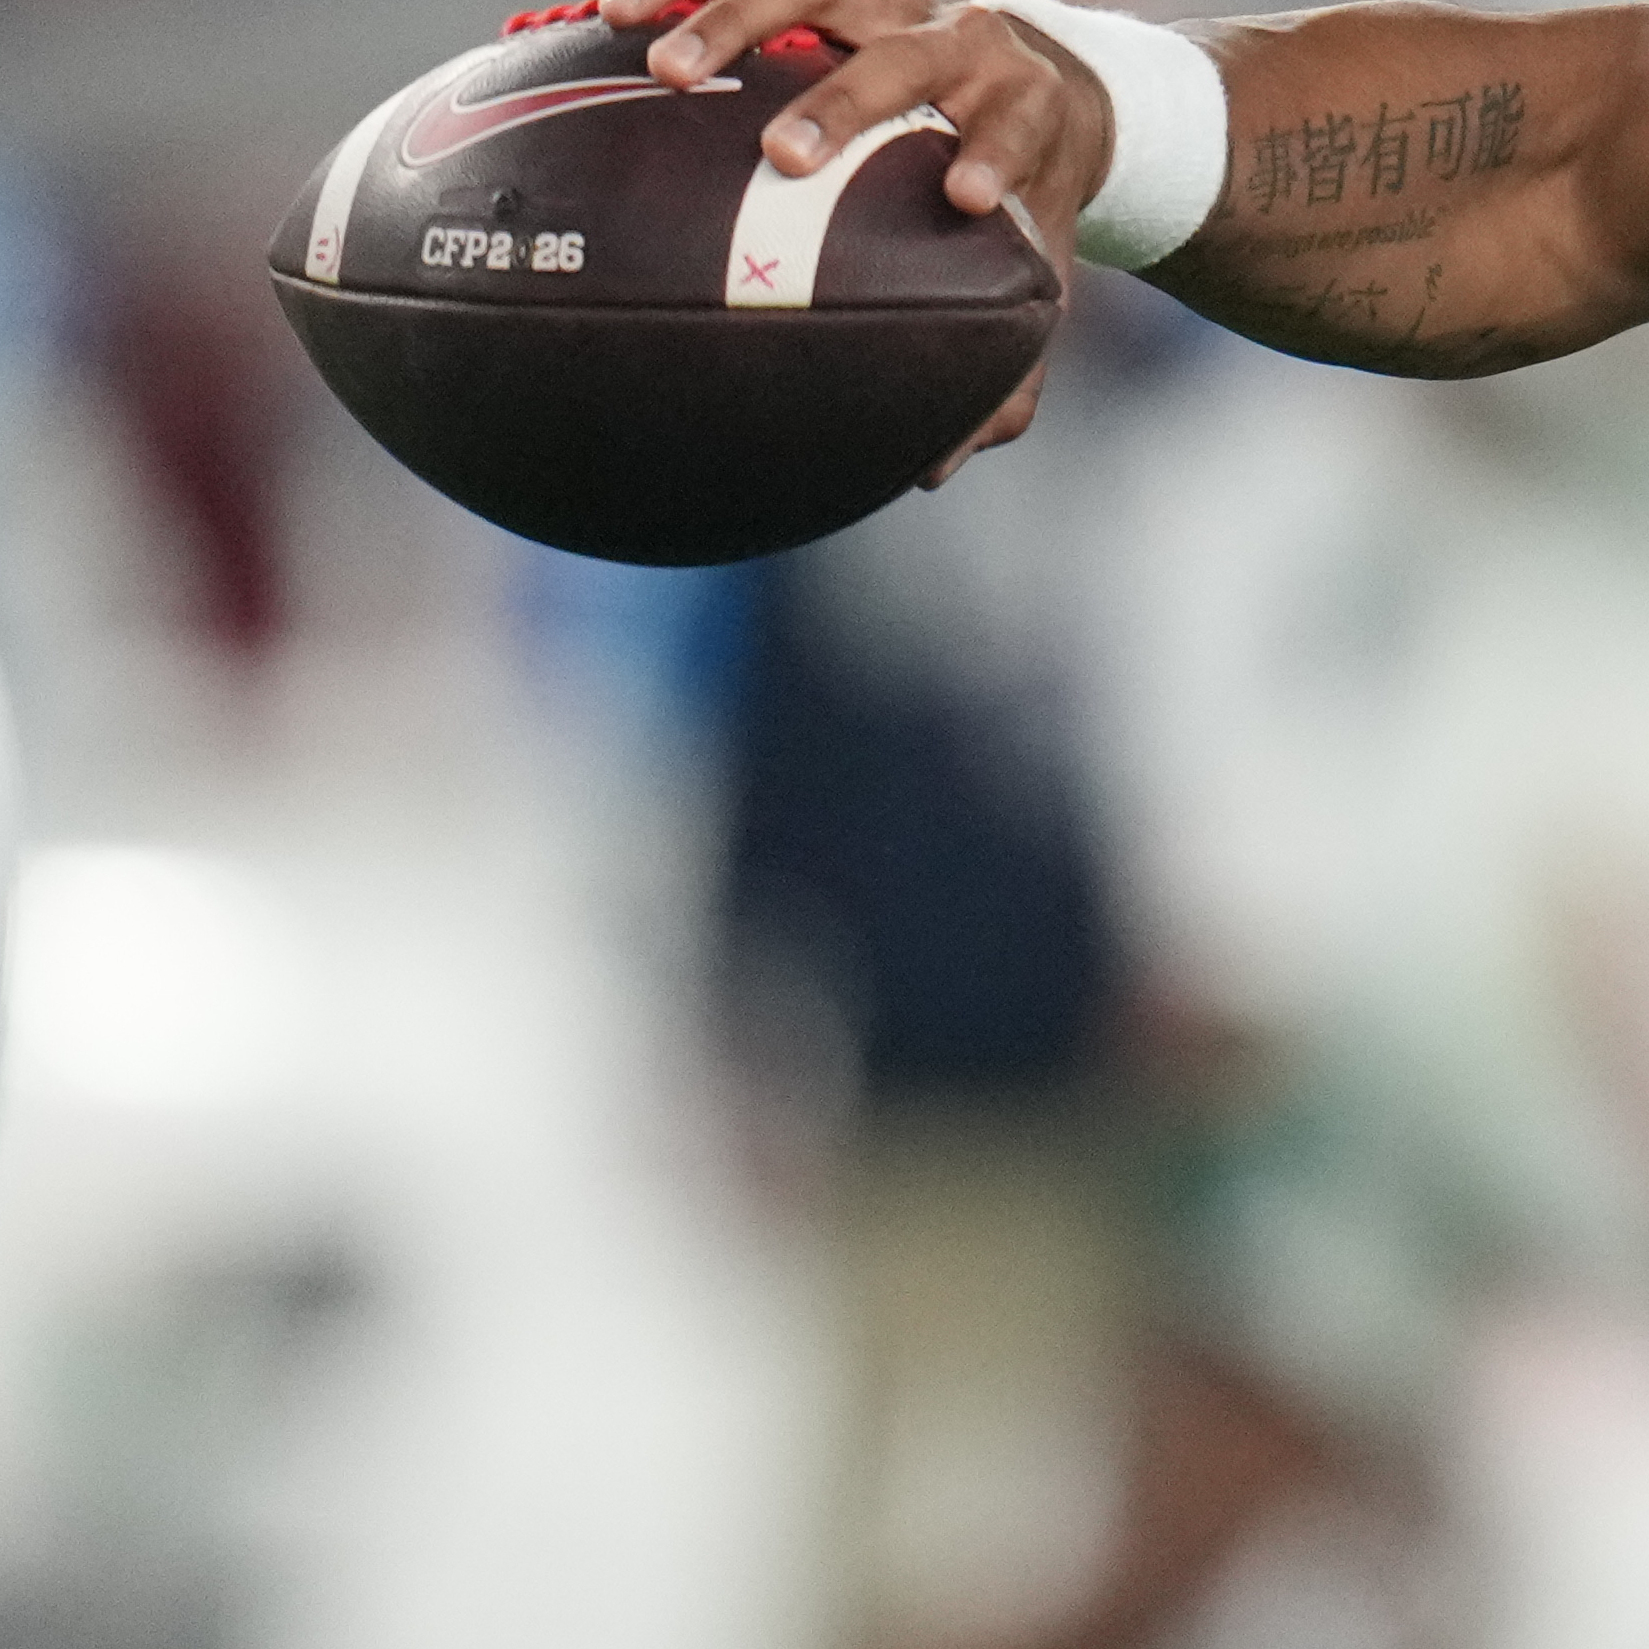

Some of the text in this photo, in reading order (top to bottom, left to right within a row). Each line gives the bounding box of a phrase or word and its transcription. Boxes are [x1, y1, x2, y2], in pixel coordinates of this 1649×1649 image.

[1229, 82, 1526, 214] 事皆有可能
